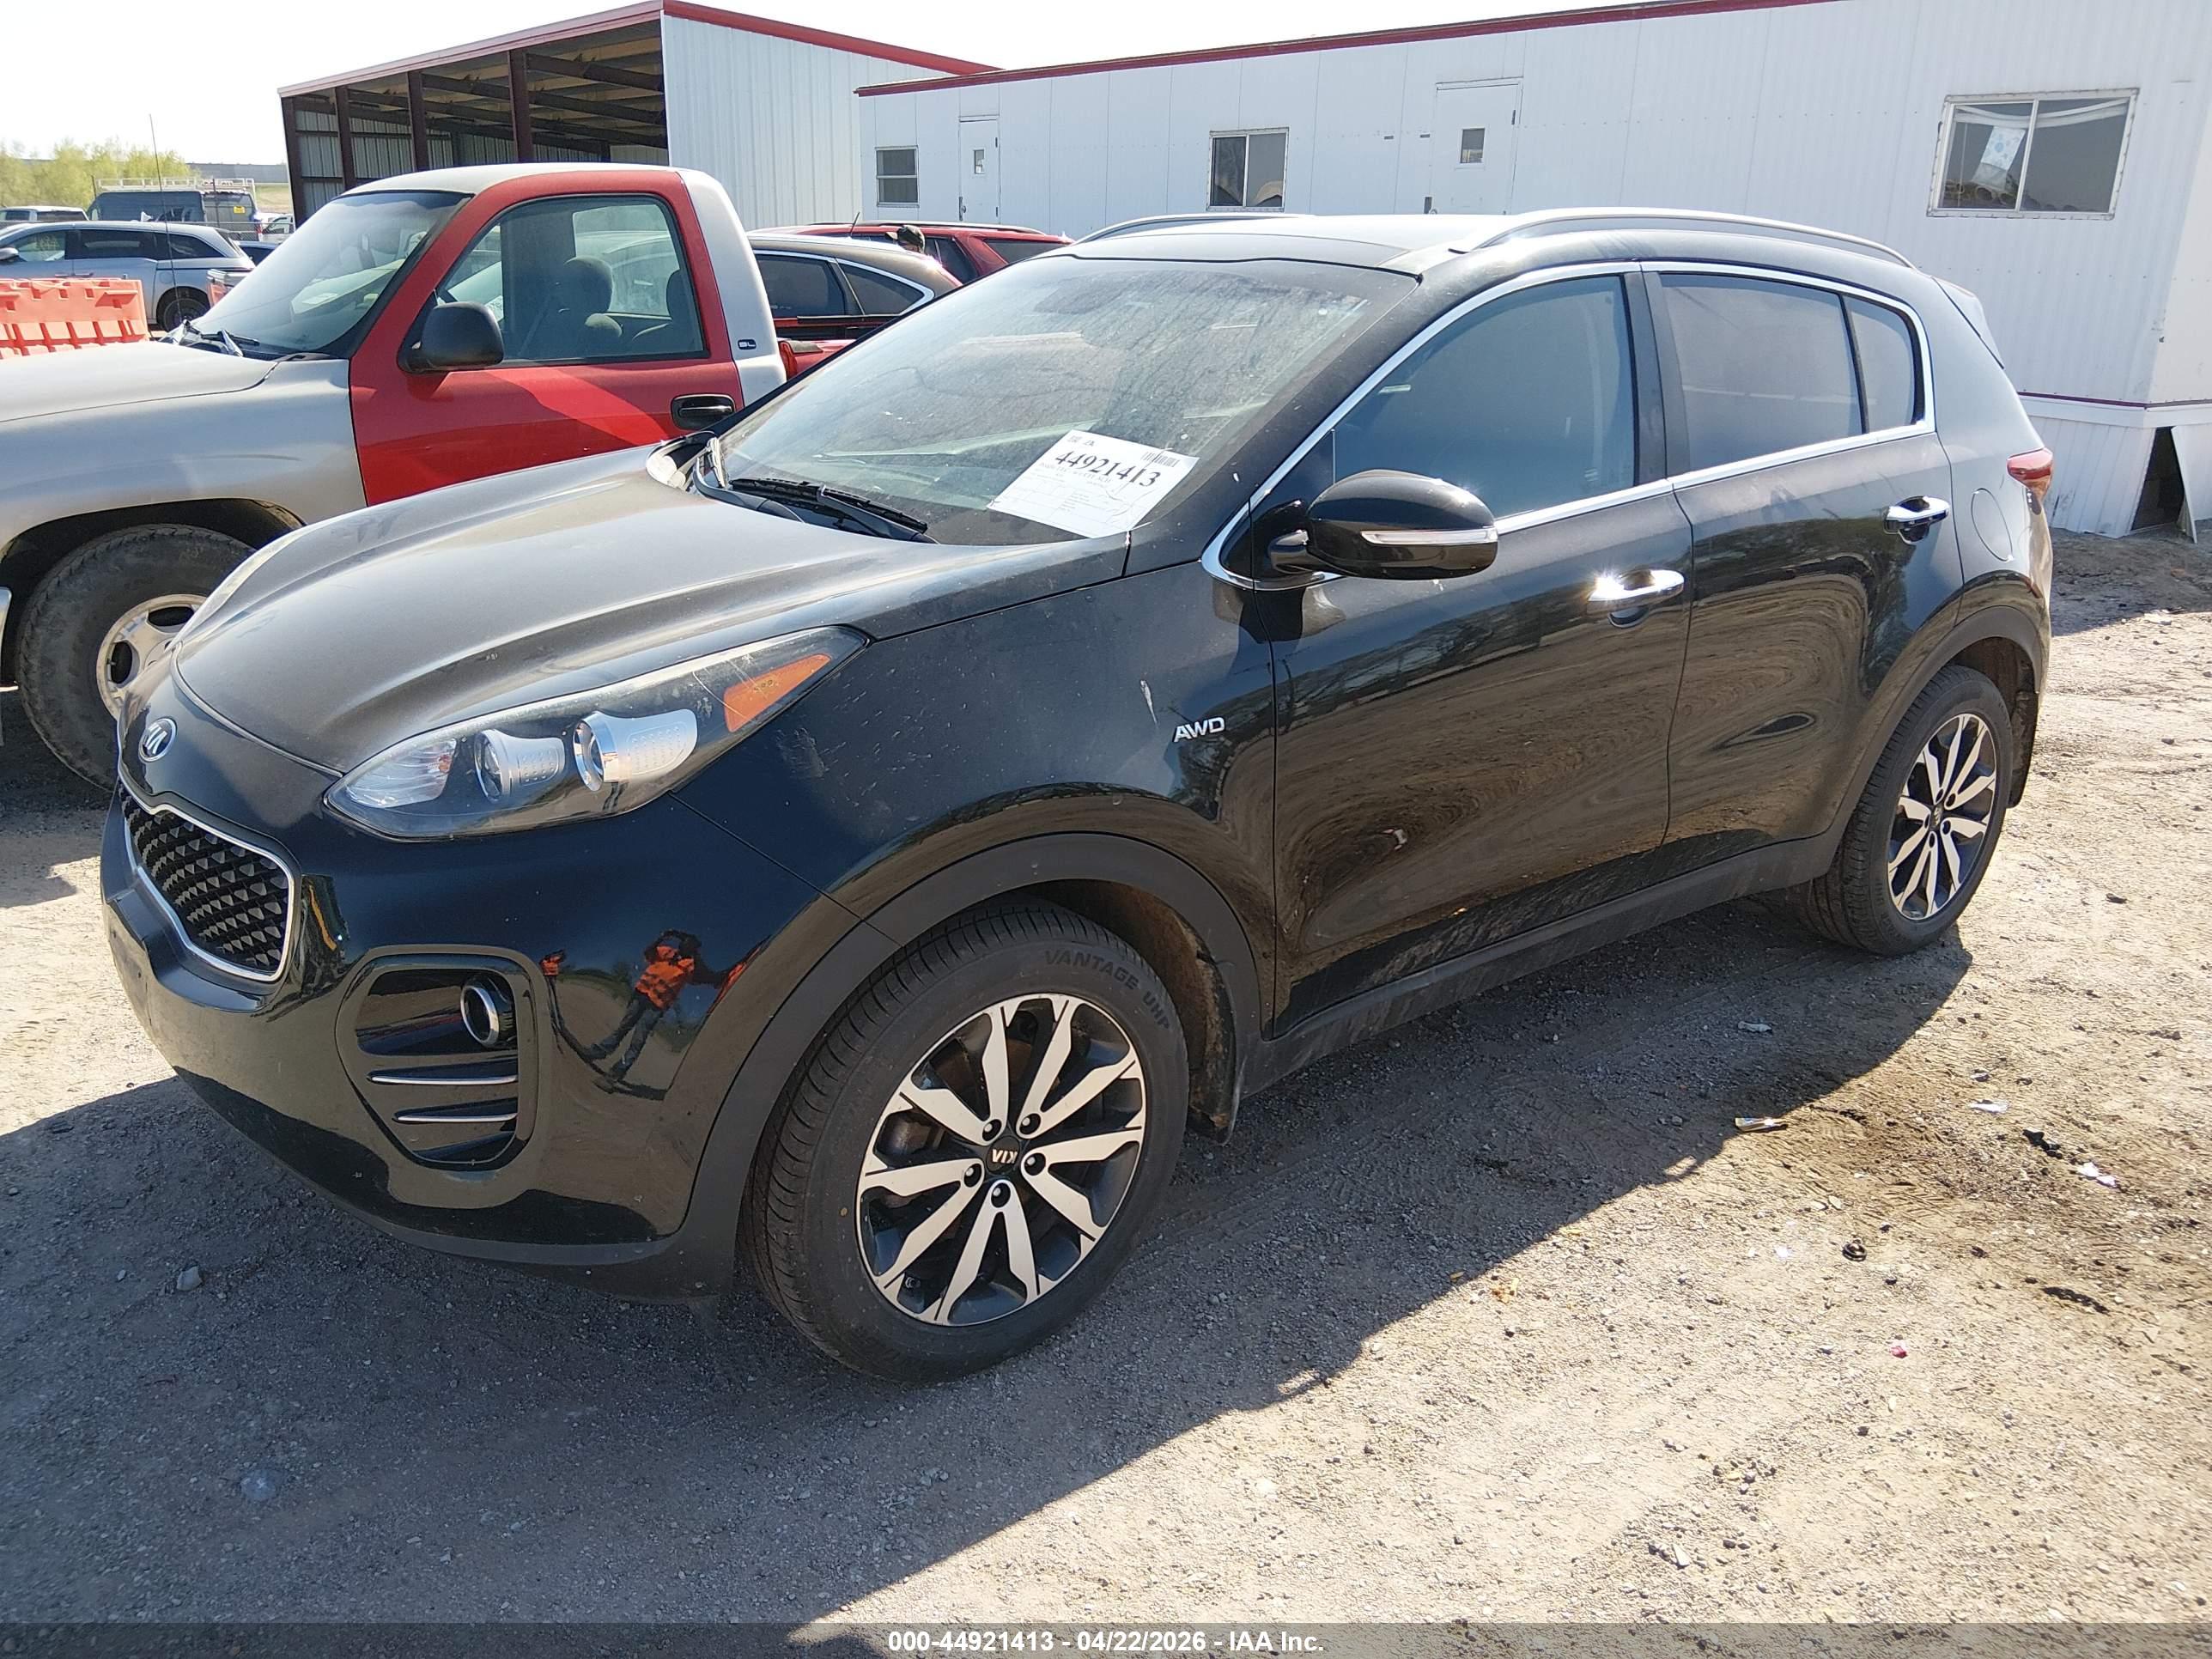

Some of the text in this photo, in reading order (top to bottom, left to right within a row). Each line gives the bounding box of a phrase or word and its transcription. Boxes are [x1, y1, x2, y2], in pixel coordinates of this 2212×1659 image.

[1055, 450, 1162, 487] 44921413
[1173, 716, 1225, 743] AWD
[1044, 949, 1170, 1030] VANTAGE UHP
[992, 1148, 1018, 1164] KIA
